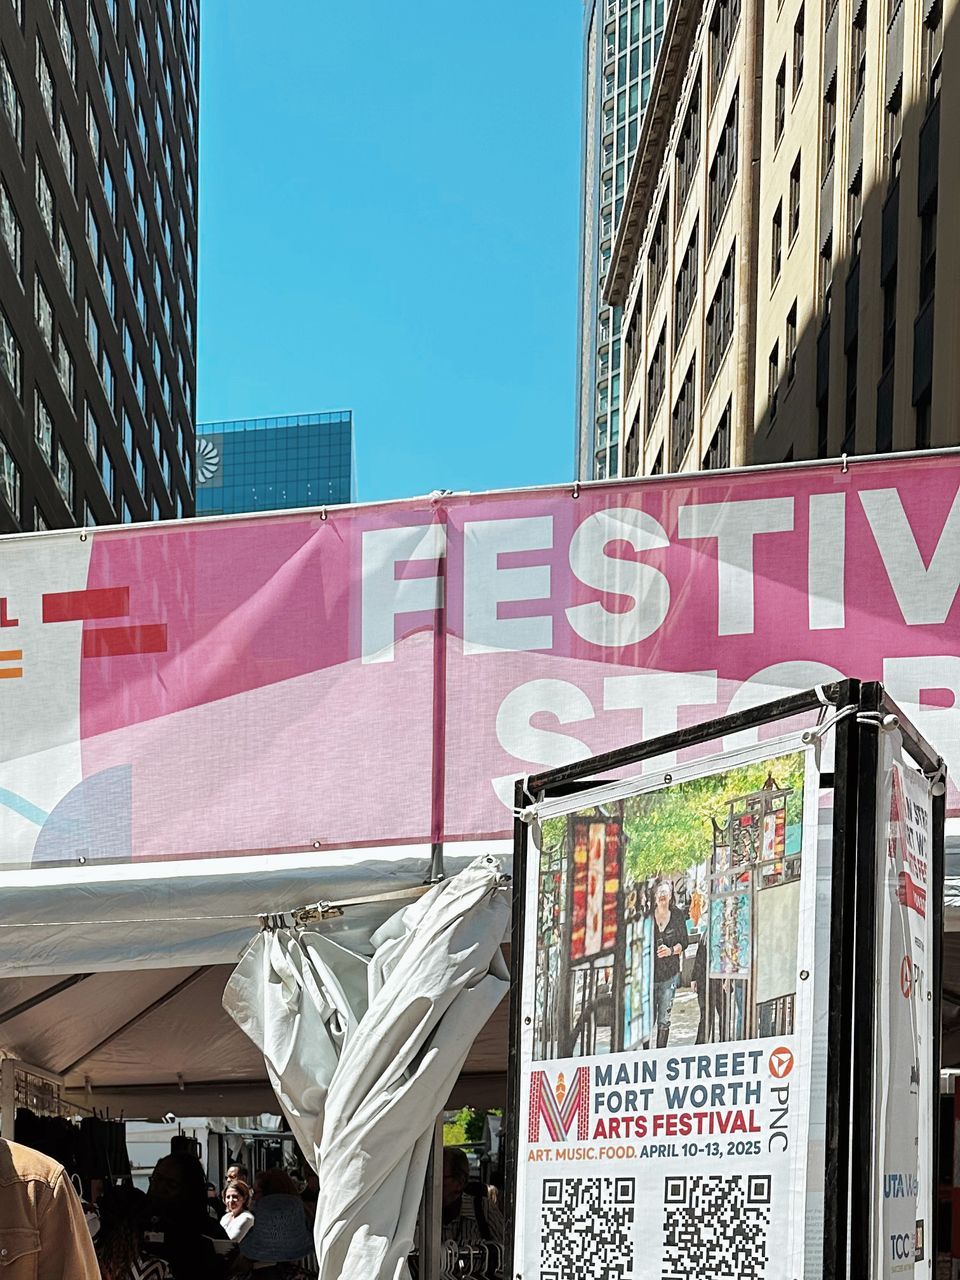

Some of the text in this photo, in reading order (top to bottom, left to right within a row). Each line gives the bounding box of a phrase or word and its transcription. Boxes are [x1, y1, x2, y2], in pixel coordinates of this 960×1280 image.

[595, 1050, 763, 1087] MAIN STREET
[595, 1080, 762, 1114] FORT WORTH
[592, 1109, 761, 1140] ARTS FESTIVAL
[768, 1082, 790, 1153] PNC
[528, 1149, 553, 1162] ART.
[640, 1144, 679, 1158] APRIL
[682, 1142, 723, 1159] 10-13,
[727, 1140, 761, 1156] 2025
[883, 1174, 904, 1198] UTA
[891, 1233, 910, 1260] TCC
